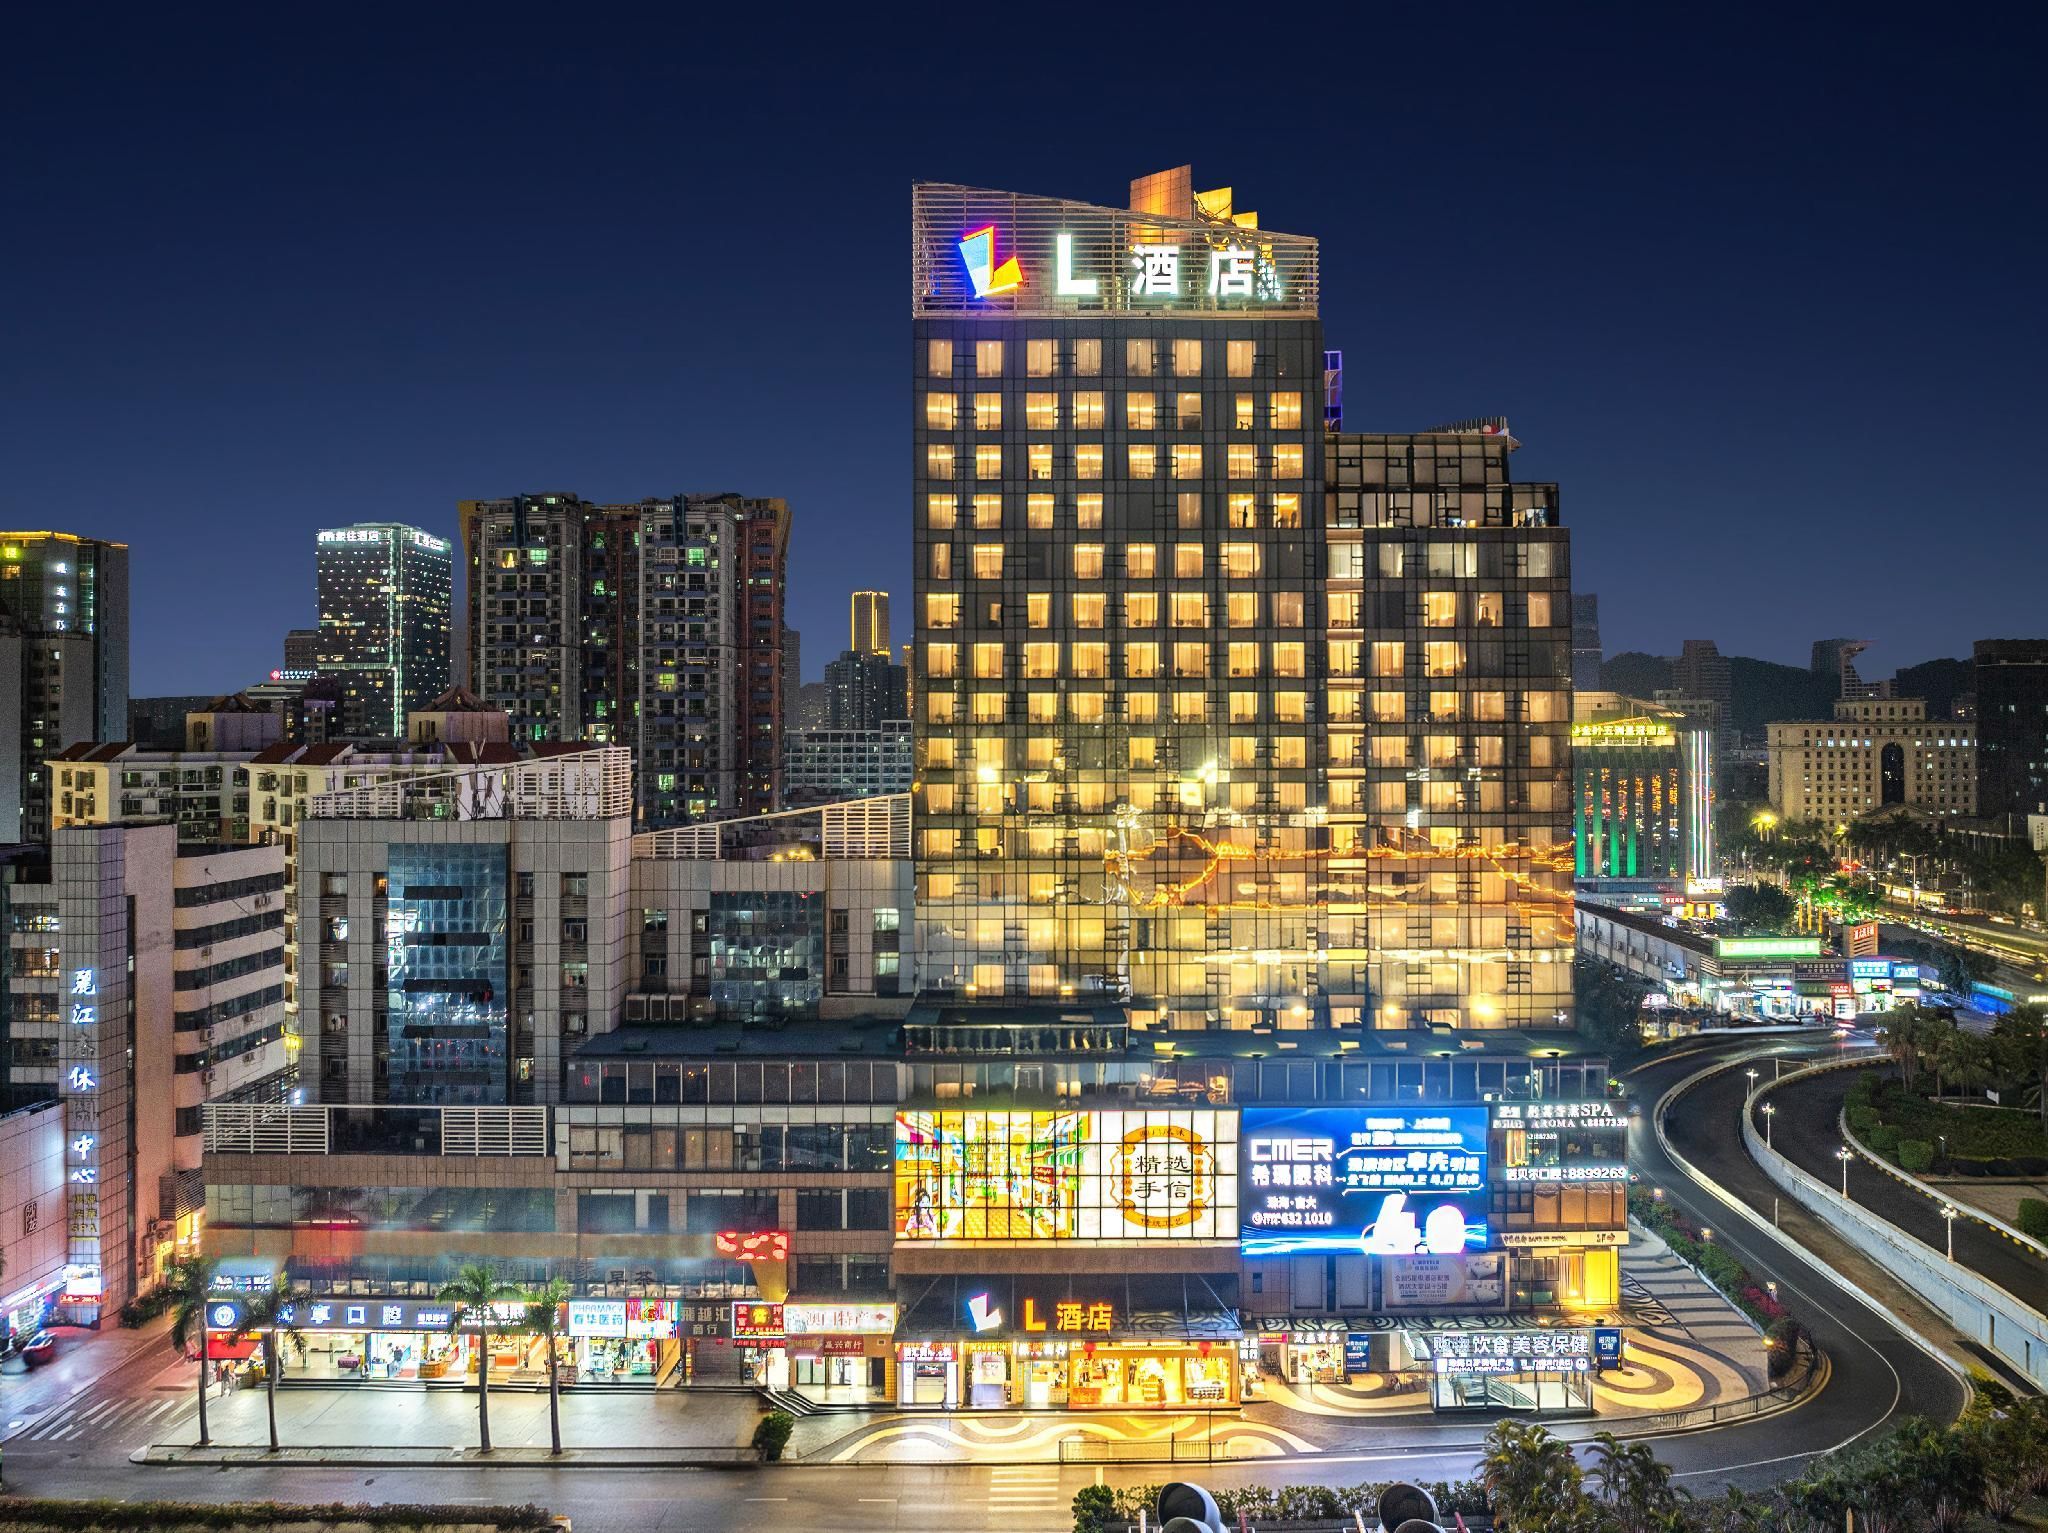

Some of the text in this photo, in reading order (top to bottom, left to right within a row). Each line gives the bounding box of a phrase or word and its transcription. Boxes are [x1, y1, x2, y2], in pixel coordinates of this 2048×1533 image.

[1057, 234, 1097, 295] L
[1131, 246, 1254, 297] 酒店
[1251, 1138, 1333, 1161] CMER
[1025, 1299, 1112, 1331] L 酒店
